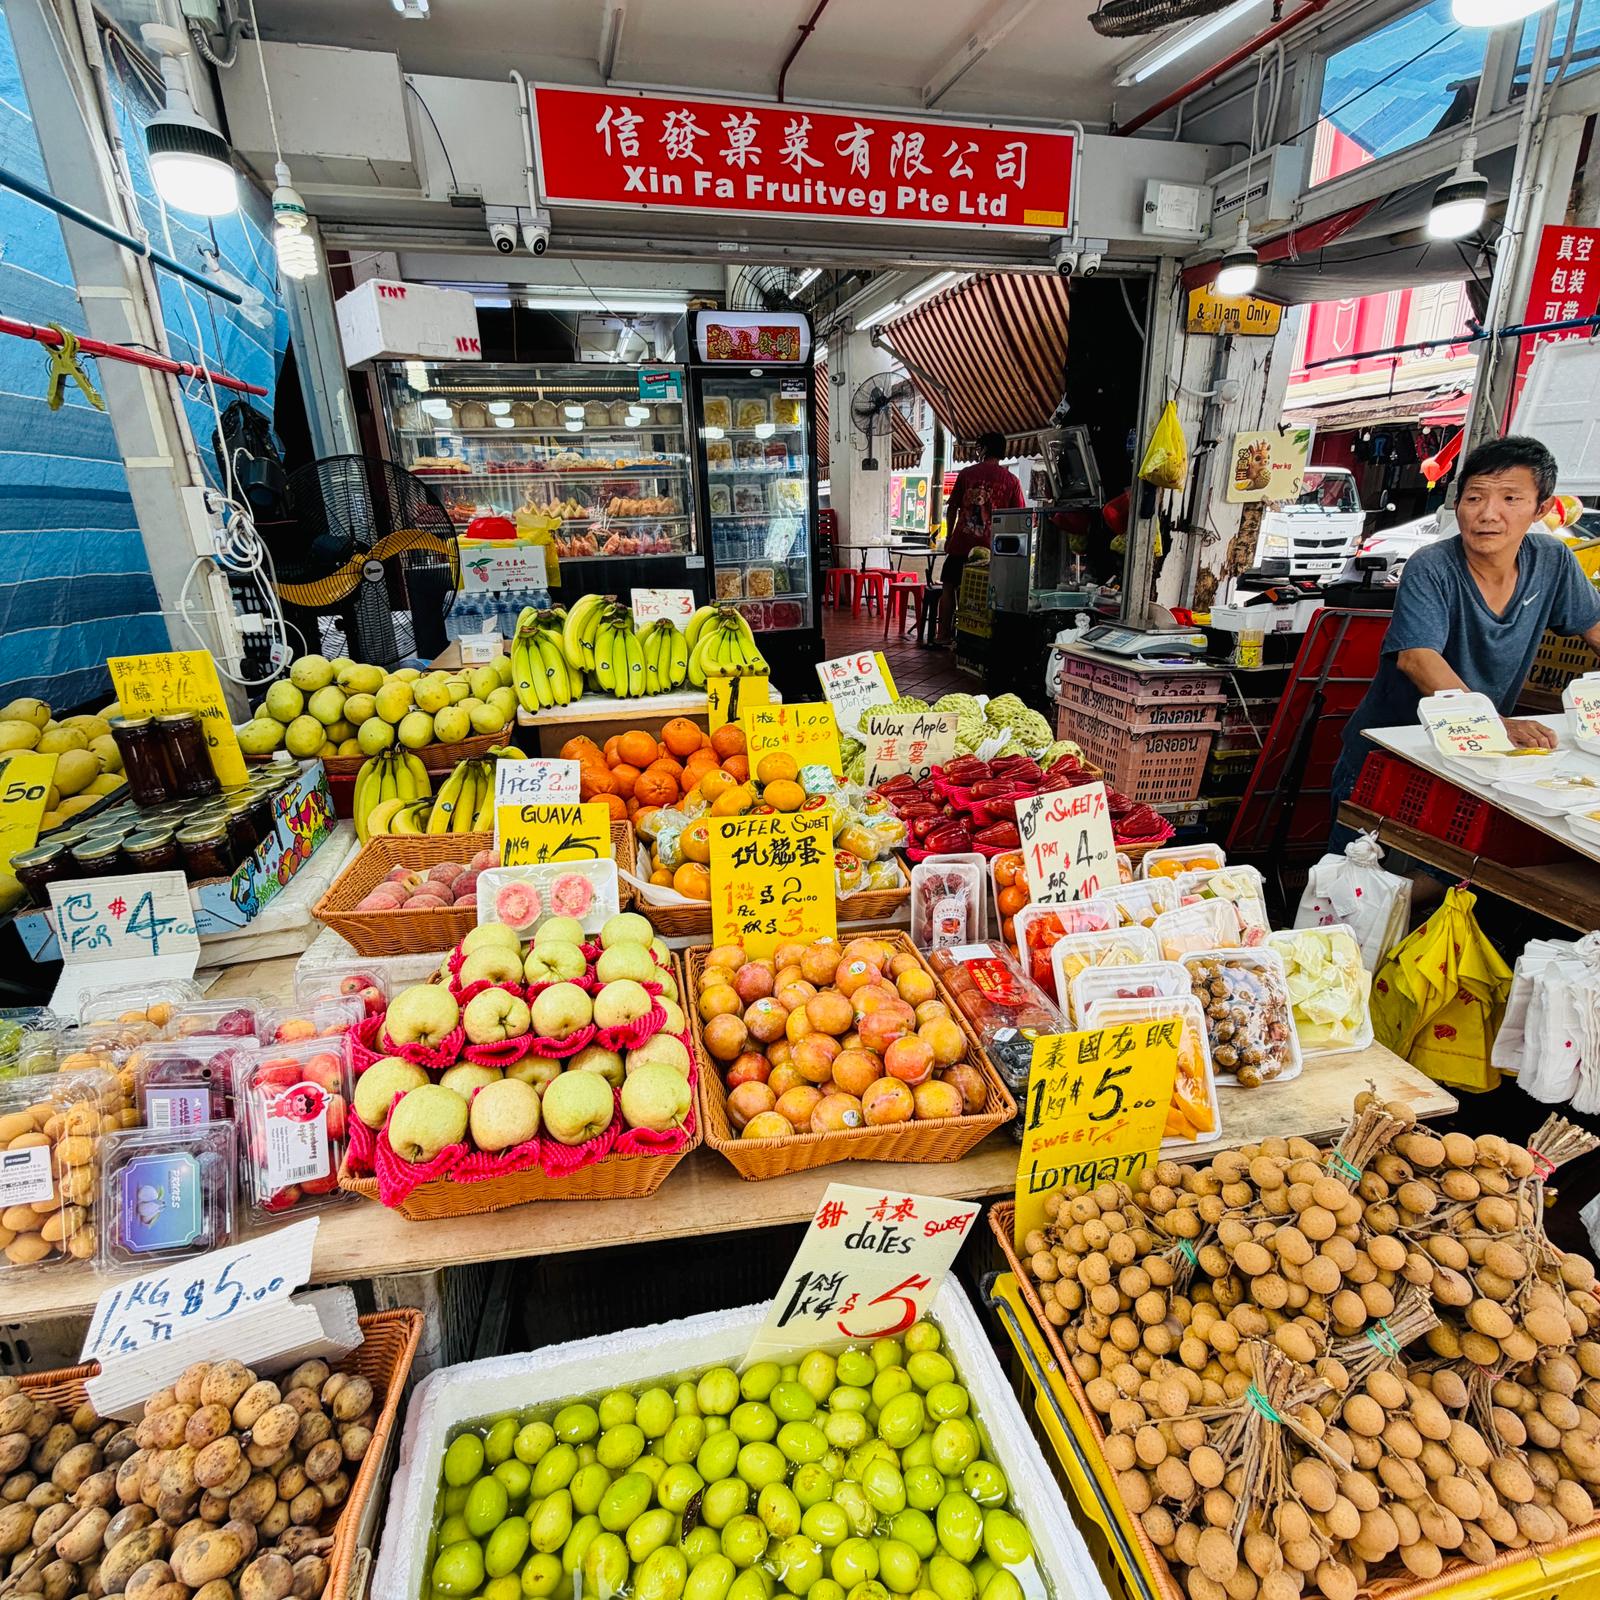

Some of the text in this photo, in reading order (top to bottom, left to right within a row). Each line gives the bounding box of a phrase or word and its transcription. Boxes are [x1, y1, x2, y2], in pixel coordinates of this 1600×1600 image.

[596, 104, 1028, 190] 信發菓菜有限公司
[624, 165, 1008, 218] Xin Fa Fruitveg Pte Ltd
[1556, 234, 1595, 262] 真空
[377, 285, 407, 299] TNT
[1550, 267, 1587, 294] 包装
[1213, 303, 1240, 321] 11am
[1246, 304, 1271, 325] Only
[870, 714, 950, 739] Wax Apple
[520, 804, 583, 826] GUAVA
[720, 818, 786, 839] OFFER
[1047, 871, 1069, 891] FOR
[71, 924, 113, 953] FOR
[1030, 1125, 1101, 1152] SWEET
[1028, 1151, 1148, 1195] Longan
[815, 1200, 848, 1229] 甜
